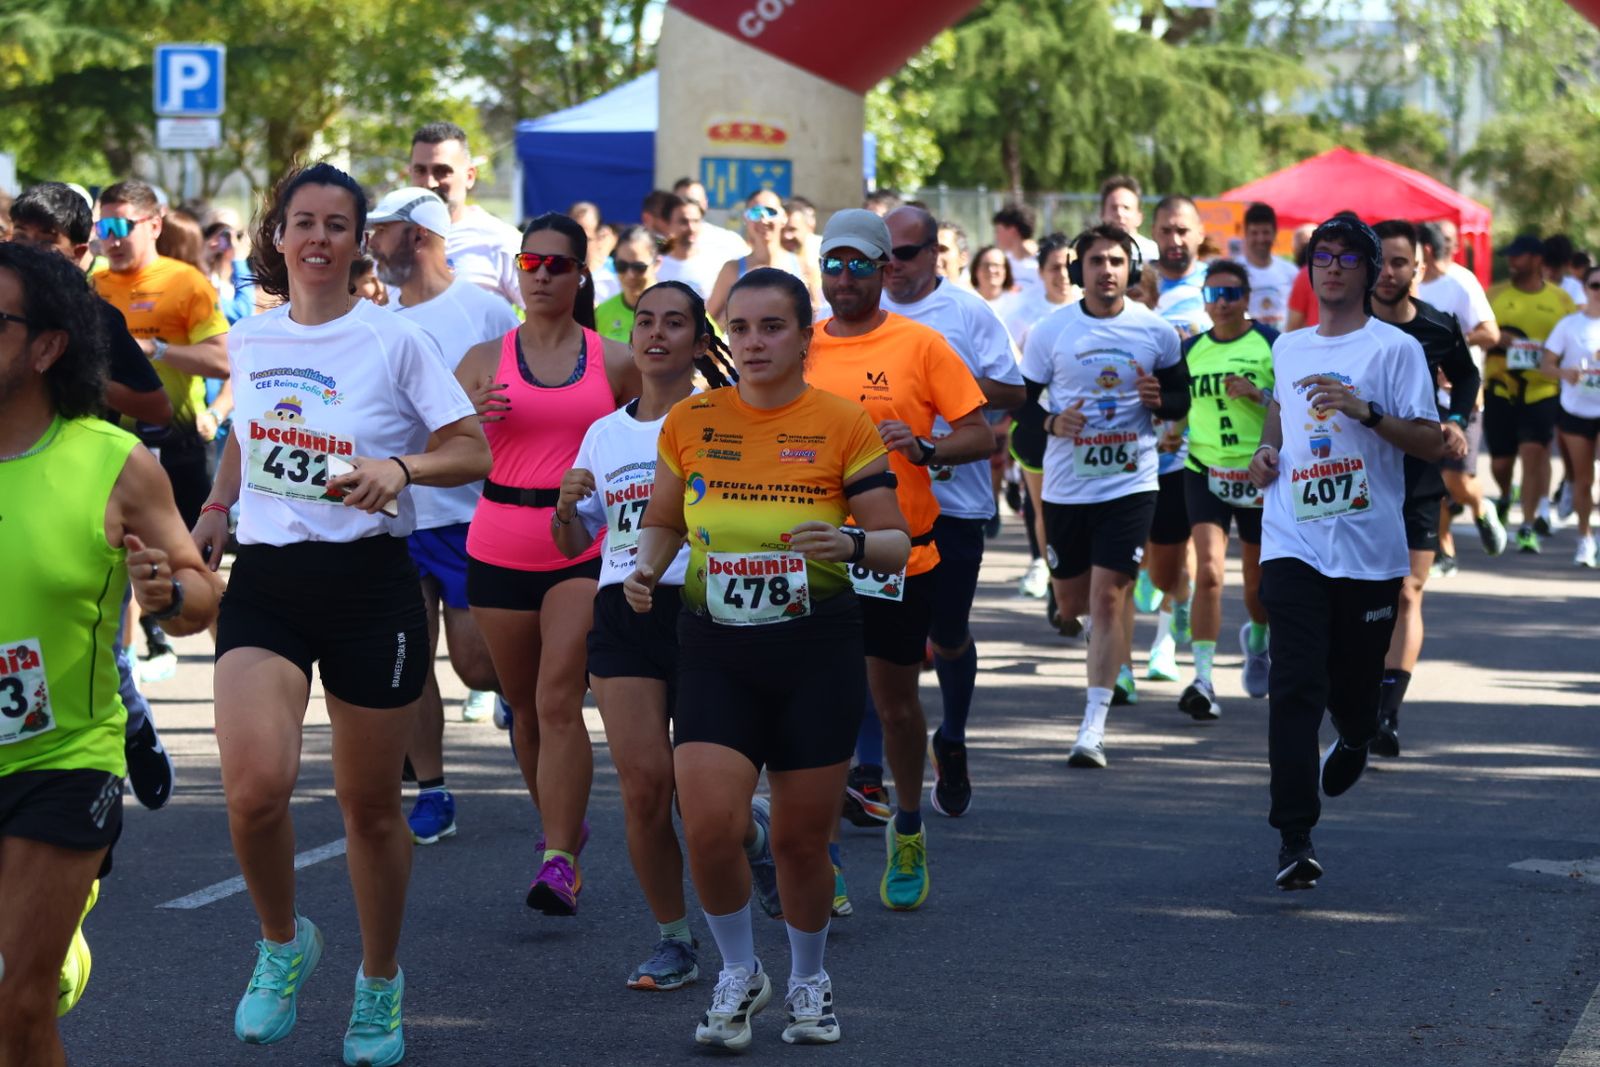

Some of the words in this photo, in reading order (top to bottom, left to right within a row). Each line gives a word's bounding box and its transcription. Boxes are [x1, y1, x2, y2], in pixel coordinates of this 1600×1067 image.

[167, 53, 210, 112] P
[255, 368, 293, 379] carrera
[293, 368, 336, 389] solidaria
[255, 380, 272, 390] CEE
[273, 379, 299, 389] Reina
[250, 421, 353, 456] bedunia
[1074, 432, 1137, 446] bedunia
[1084, 444, 1128, 467] 406
[1292, 457, 1364, 484] bedunia
[709, 480, 763, 491] ESCUELA
[1219, 480, 1258, 499] 386
[1303, 474, 1353, 506] 407
[722, 492, 815, 505] SALMANTINA
[709, 555, 804, 577] bedunia
[724, 576, 791, 609] 478
